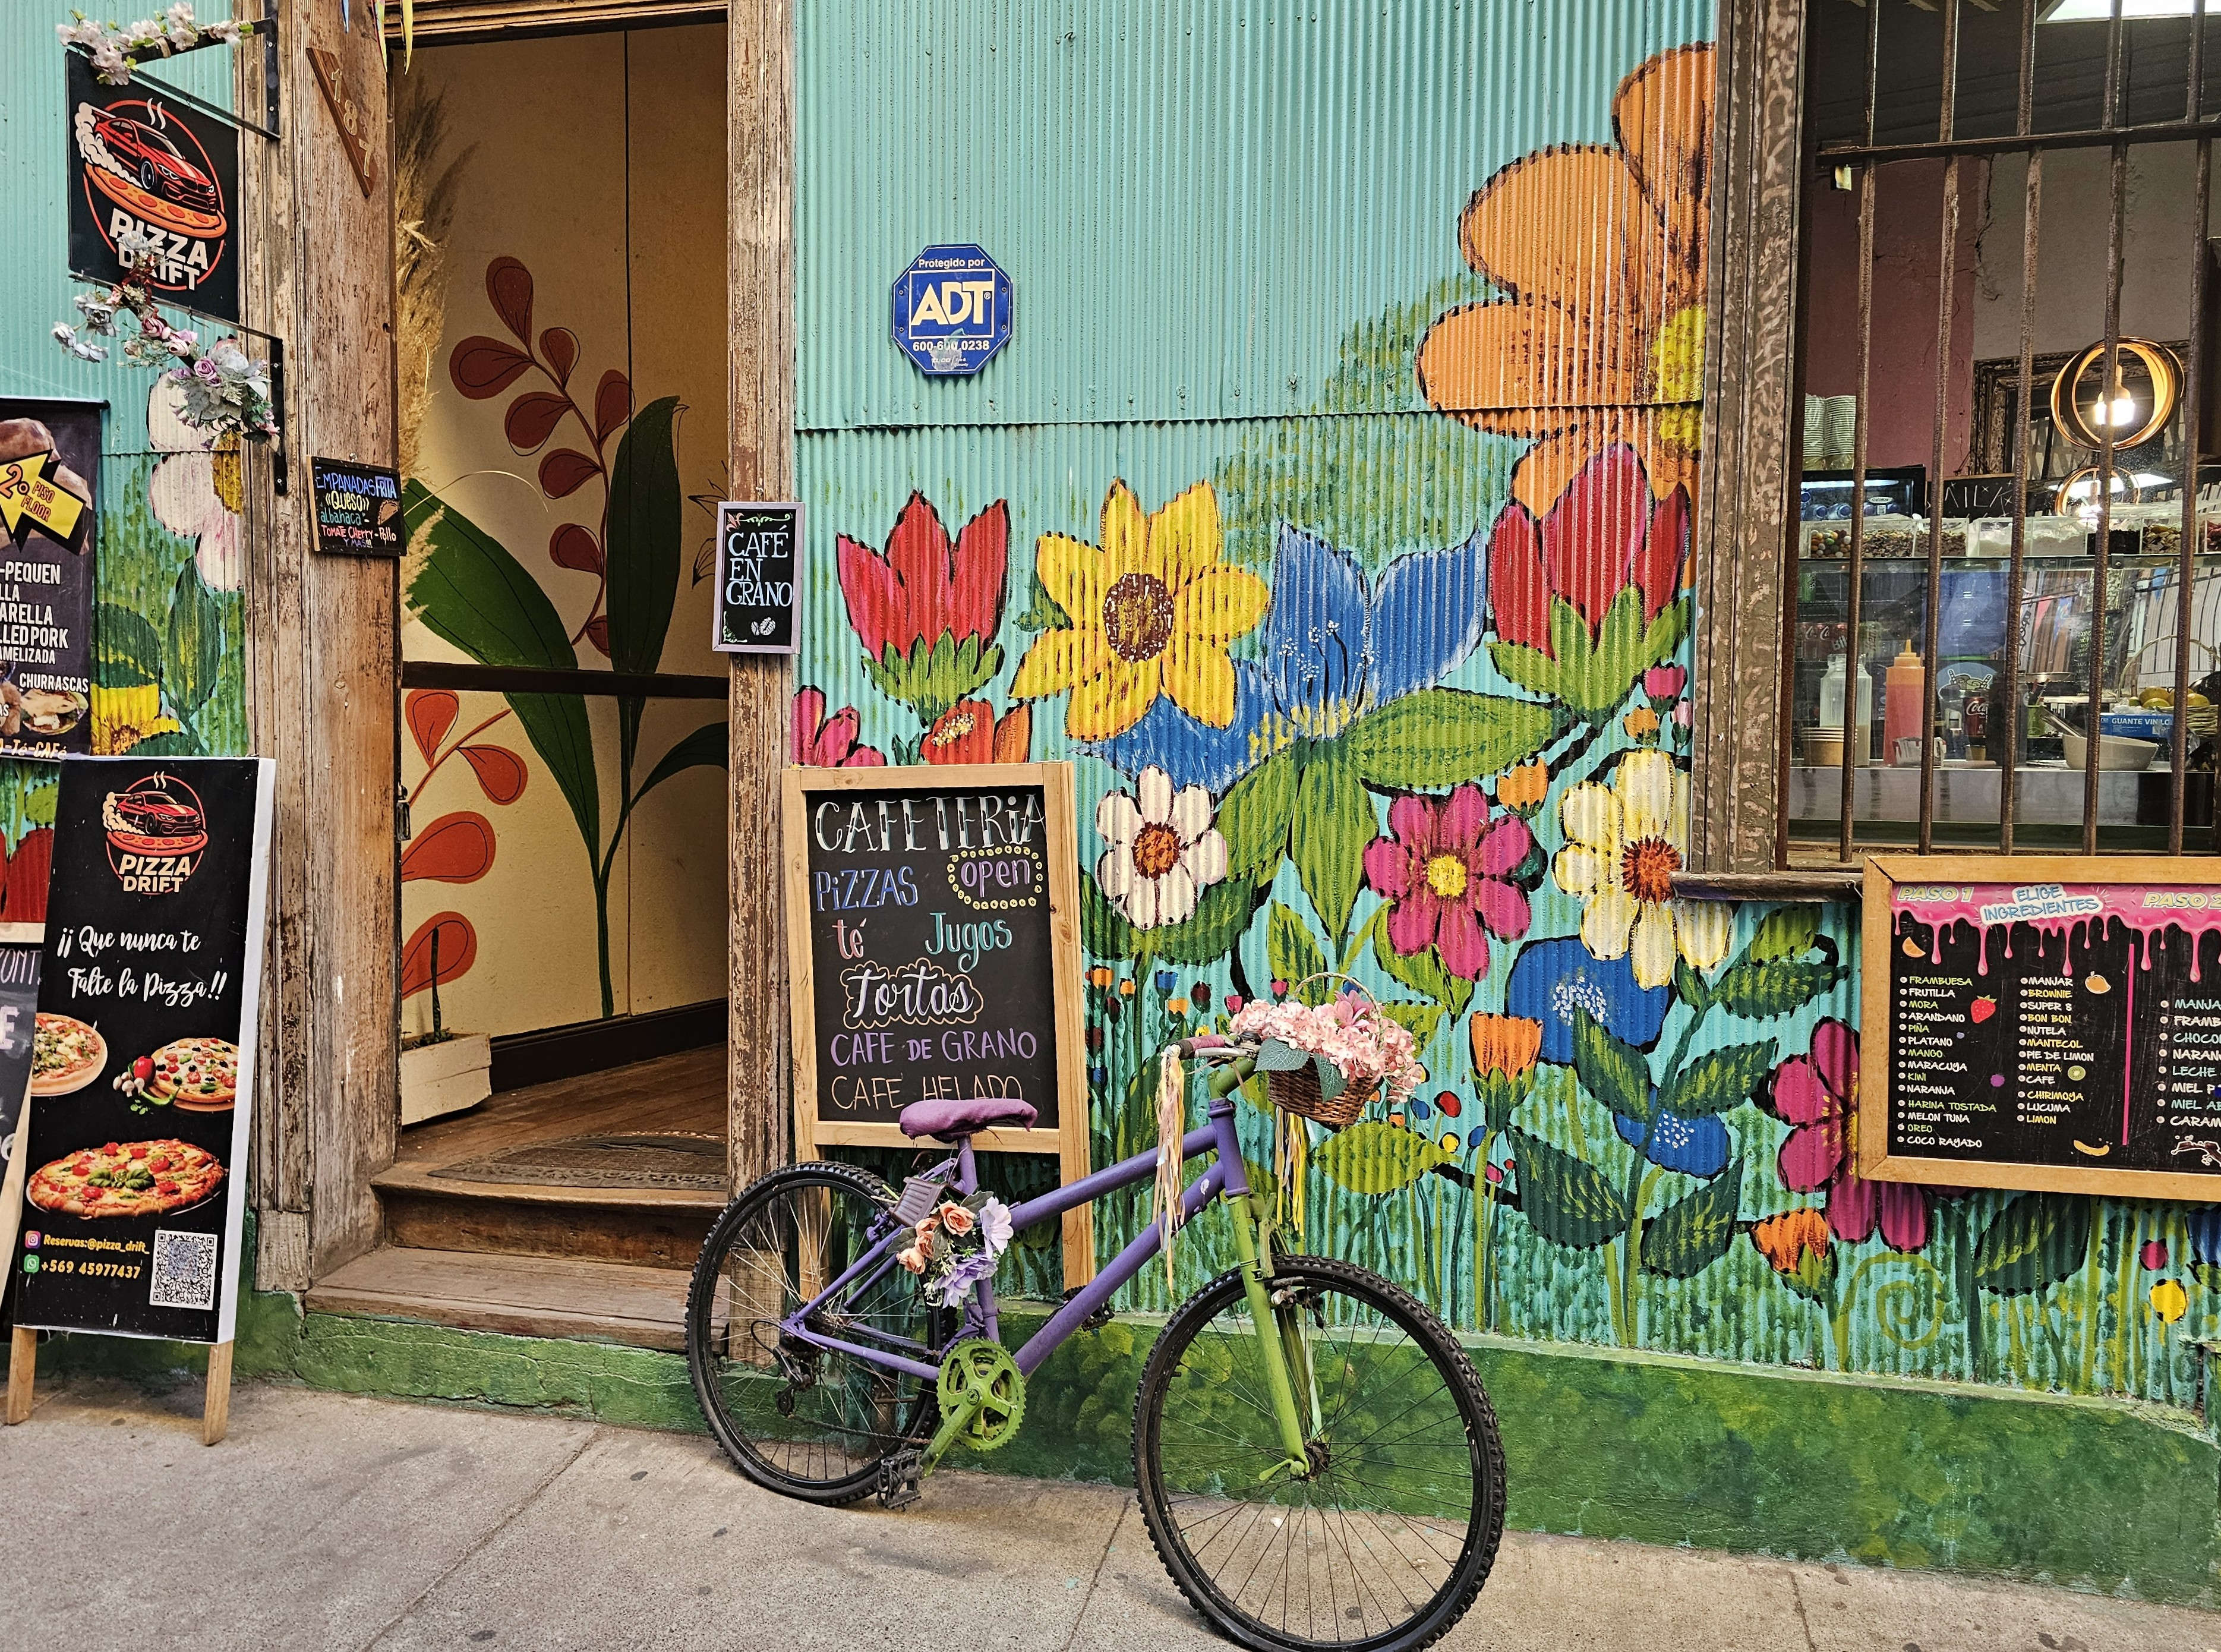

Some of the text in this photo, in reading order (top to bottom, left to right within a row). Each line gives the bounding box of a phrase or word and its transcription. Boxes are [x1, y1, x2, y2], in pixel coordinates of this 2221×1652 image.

[331, 68, 376, 178] 187
[109, 208, 209, 270] PIZZA
[118, 242, 200, 291] DIFT
[919, 258, 985, 269] Protegido por
[961, 340, 990, 351] 0238
[315, 466, 377, 497] EMPANADAS
[32, 481, 55, 503] PISO
[21, 494, 51, 522] FLOOR
[321, 525, 347, 538] TOMATE
[378, 527, 397, 542] Pollo
[728, 525, 788, 559] CAFÉ
[729, 558, 764, 582] EN
[725, 581, 793, 607] GRANO
[30, 626, 69, 649] PORK
[20, 673, 89, 693] CHURRASCAS
[119, 855, 191, 877] PIZZA
[961, 858, 1030, 898] open
[123, 877, 184, 893] DRIFT
[1897, 885, 1974, 902] PASO 1
[2015, 886, 2063, 902] ELIGE
[2142, 892, 2206, 909] PASO
[1984, 898, 2099, 920] INGREDIENTES
[120, 933, 178, 952] nunca
[180, 929, 201, 951] te
[832, 912, 1012, 973] té Jugos
[68, 966, 113, 998] Falte
[119, 967, 138, 998] la
[1909, 976, 1973, 986] FRAMBUESA
[2028, 977, 2073, 986] MANJAR
[846, 966, 974, 1018] Tortas
[1908, 988, 1956, 998] FRUTILLA
[2027, 989, 2072, 998] BROWNIE
[1908, 1001, 1939, 1009] MORA
[2027, 1002, 2062, 1010] SUPER
[1908, 1012, 1966, 1023] ARANDANO
[2027, 1014, 2072, 1023] BON BON
[1908, 1023, 1930, 1033] PIÑA
[2027, 1026, 2066, 1036] NUTELA
[1908, 1036, 1953, 1046] PLATANO
[2027, 1039, 2083, 1048] MANTECOL
[2173, 1032, 2221, 1044] CHOCO
[830, 1028, 1037, 1067] CAFE DE GRANO
[1908, 1049, 1943, 1058] MANGO
[2027, 1051, 2094, 1062] PIE DE LIMON
[2172, 1048, 2221, 1061] NARAN
[1907, 1061, 1968, 1073] MARACUYA
[2026, 1063, 2061, 1073] MENTA
[2172, 1065, 2217, 1077] LECHE
[1907, 1072, 1926, 1082] KIWI
[2026, 1076, 2055, 1084] CAFE
[831, 1074, 905, 1111] CAFE
[1907, 1084, 1955, 1095] NARANJA
[2171, 1082, 2203, 1093] MIEL
[2027, 1091, 2084, 1102] CHIRIMOYA
[1908, 1100, 1997, 1112] HARINA TOSTADA
[2027, 1102, 2071, 1112] LUCUMA
[2171, 1099, 2202, 1109] MIEL
[1908, 1112, 1970, 1123] MELON TUNA
[2027, 1115, 2056, 1124] LIMON
[1907, 1124, 1933, 1133] OREO
[1907, 1136, 1982, 1147] COCO RAYADO
[42, 1259, 140, 1279] +569 45977437
